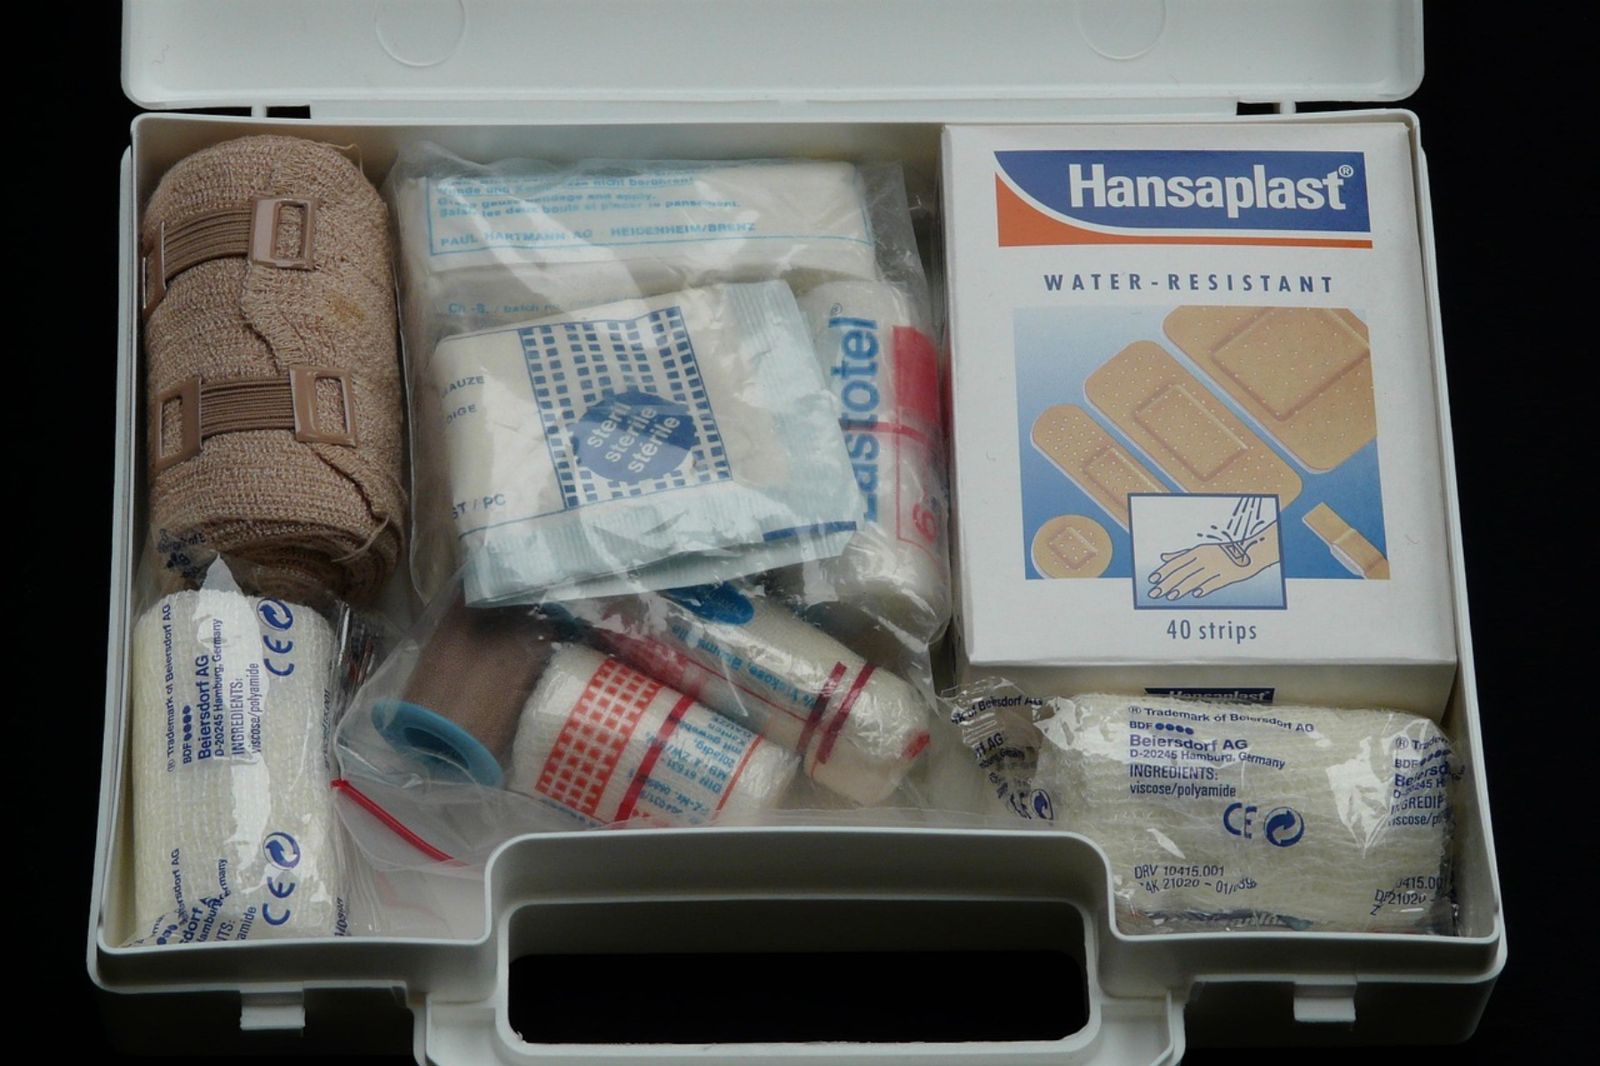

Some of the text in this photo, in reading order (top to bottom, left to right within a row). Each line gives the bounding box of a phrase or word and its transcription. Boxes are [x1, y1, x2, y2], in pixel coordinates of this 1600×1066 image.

[440, 233, 479, 247] PAUL
[1043, 273, 1334, 294] WATER-RESISTANT
[586, 401, 632, 448] steril
[604, 407, 657, 463] sterile
[161, 603, 172, 622] AG
[1167, 619, 1257, 645] 40 strips
[164, 625, 175, 682] Beiersdorf
[195, 653, 212, 761] Beiersdorf AG
[229, 677, 246, 756] INGREDIENTS:
[246, 662, 264, 754] viscose/polyamide
[1144, 707, 1210, 722] Trademark
[1214, 713, 1227, 722] of
[165, 694, 176, 757] Trademark
[212, 707, 225, 758] D-20245
[1129, 720, 1153, 730] BDF
[182, 742, 193, 765] BDF
[1129, 733, 1248, 752] Beiersdorf AG
[1130, 748, 1178, 760] D-20245
[1238, 751, 1286, 771] Germany
[1129, 764, 1219, 781] INGREDIENTS:
[1129, 782, 1237, 799] viscose/polyamide
